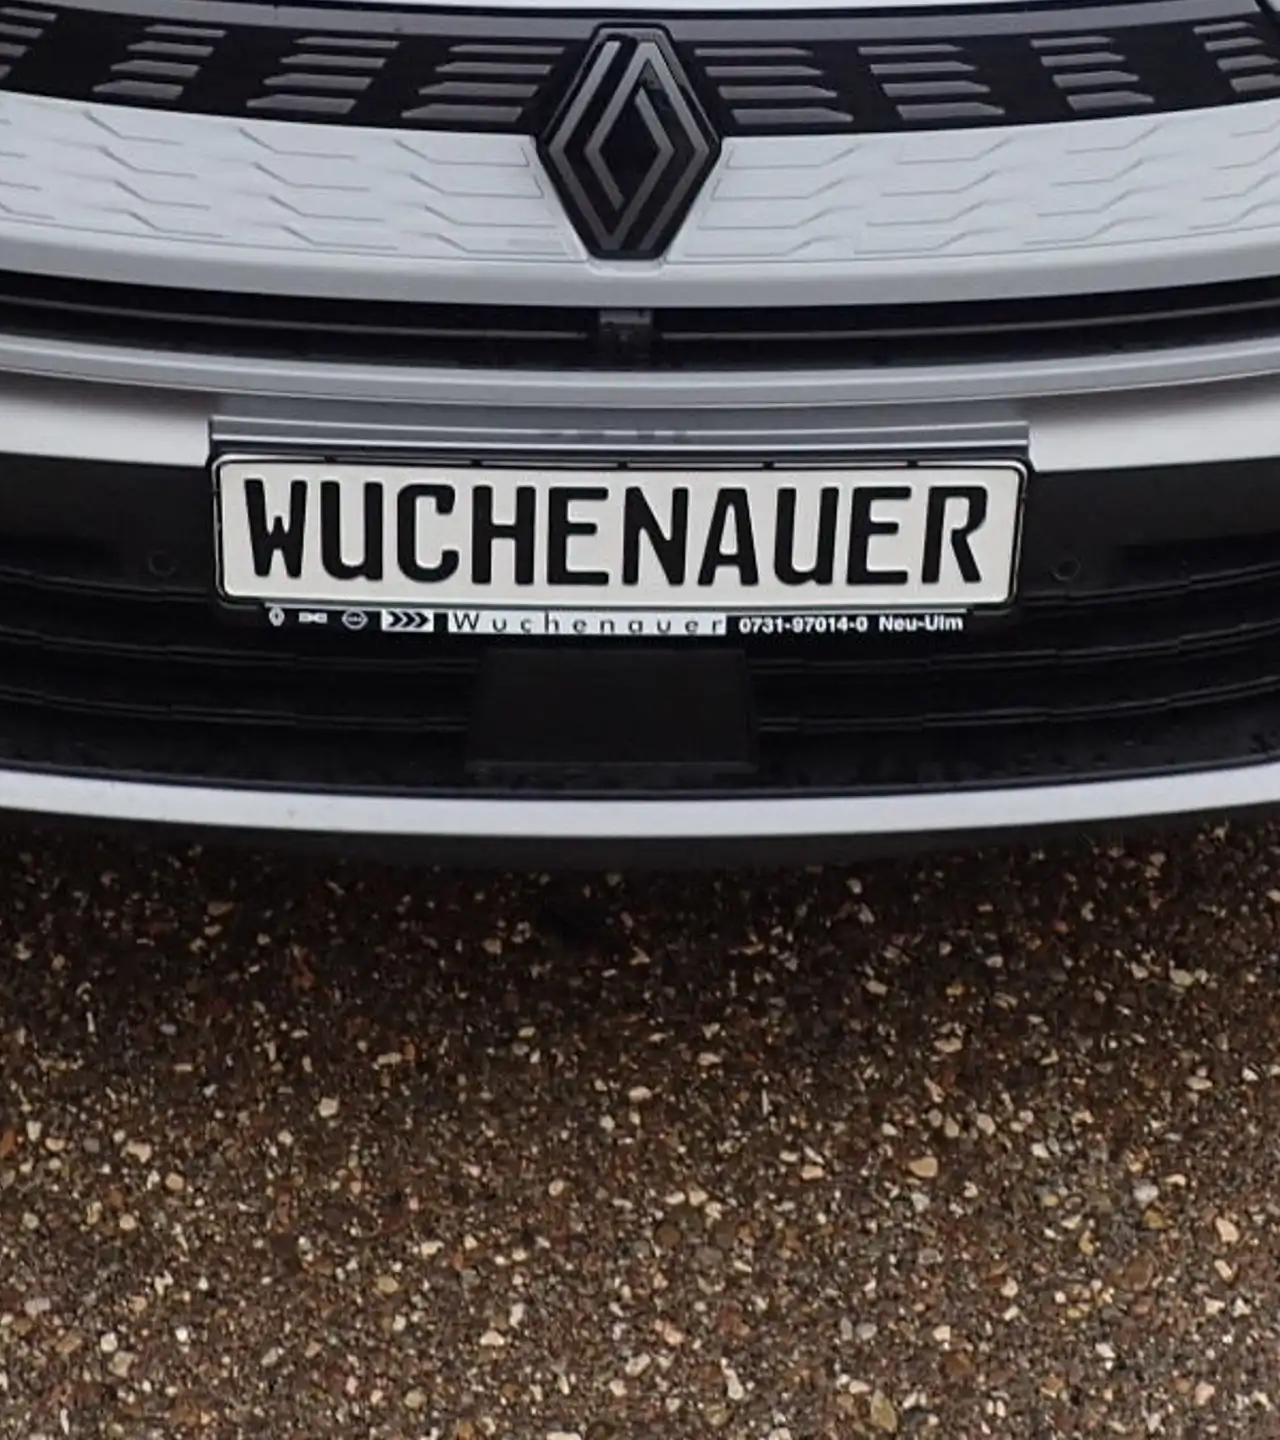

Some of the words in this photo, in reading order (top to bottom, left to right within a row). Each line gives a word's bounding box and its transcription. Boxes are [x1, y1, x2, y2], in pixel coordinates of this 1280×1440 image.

[243, 478, 988, 587] WUCHENAUER
[453, 612, 725, 635] Wuchenauer
[738, 616, 868, 633] 0731-97014-0
[878, 614, 964, 632] Neu-Ulm
